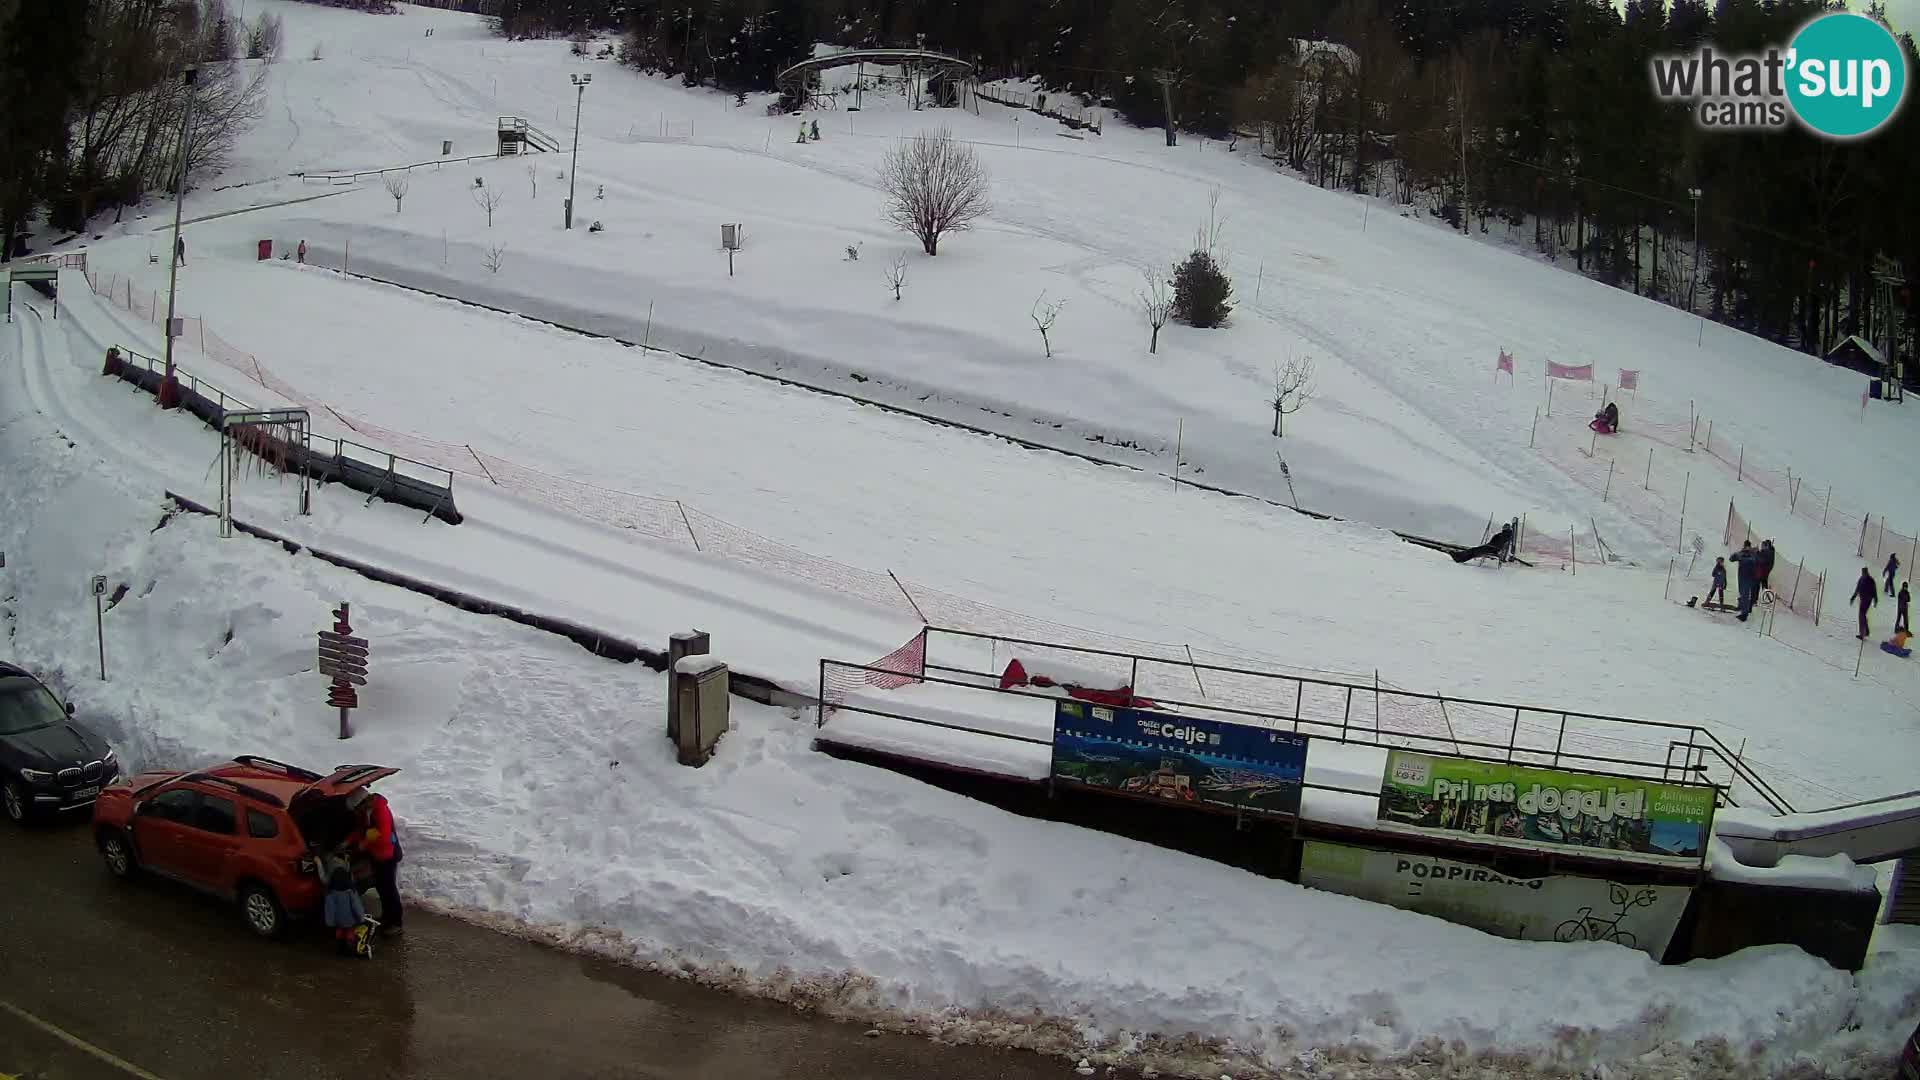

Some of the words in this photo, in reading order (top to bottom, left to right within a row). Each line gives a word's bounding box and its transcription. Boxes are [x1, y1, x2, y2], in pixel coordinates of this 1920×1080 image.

[1161, 723, 1206, 745] Celje
[1433, 778, 1469, 801] Pri
[1473, 782, 1516, 803] nas
[1517, 783, 1648, 822] dogaja!
